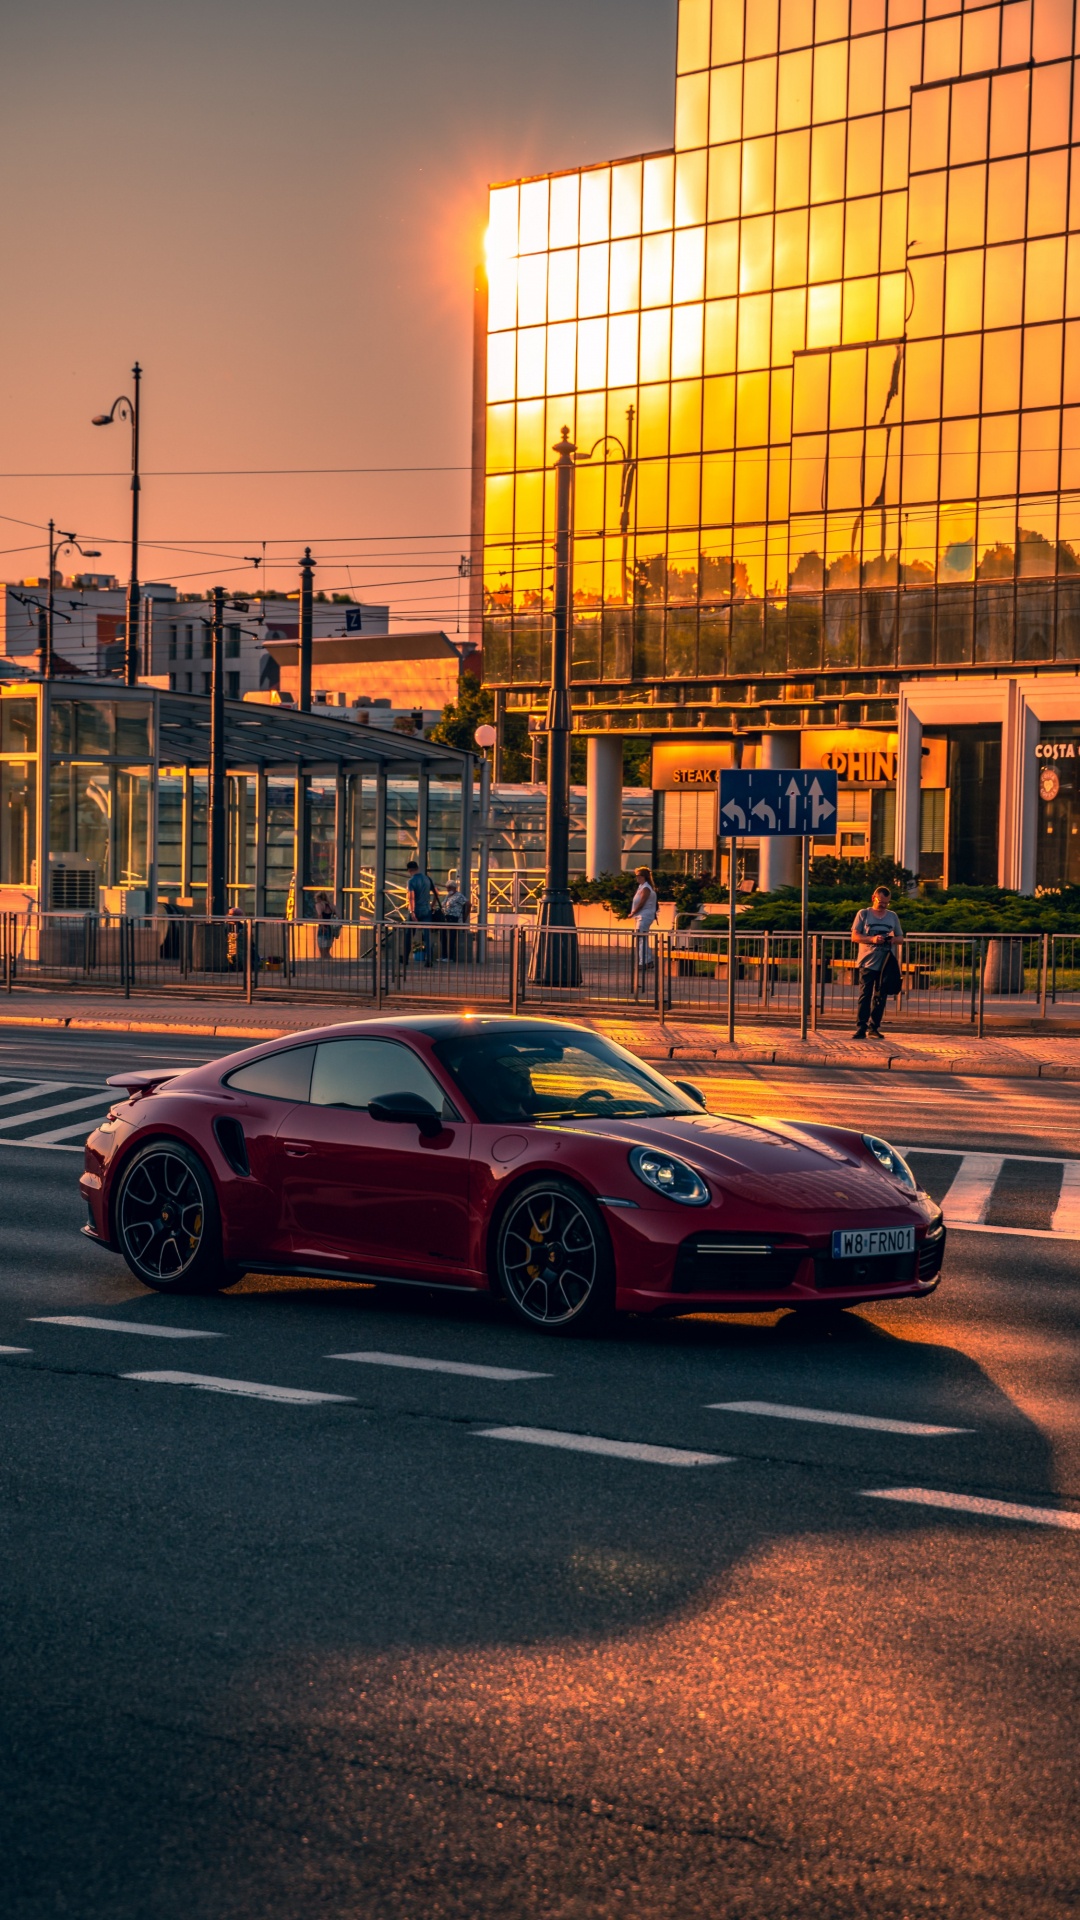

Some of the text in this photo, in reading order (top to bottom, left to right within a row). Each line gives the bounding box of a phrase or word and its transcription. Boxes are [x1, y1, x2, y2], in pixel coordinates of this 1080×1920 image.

[1035, 744, 1076, 760] COSTA
[821, 751, 899, 781] SPHIN
[673, 769, 712, 783] STEAK
[844, 1233, 863, 1254] W8
